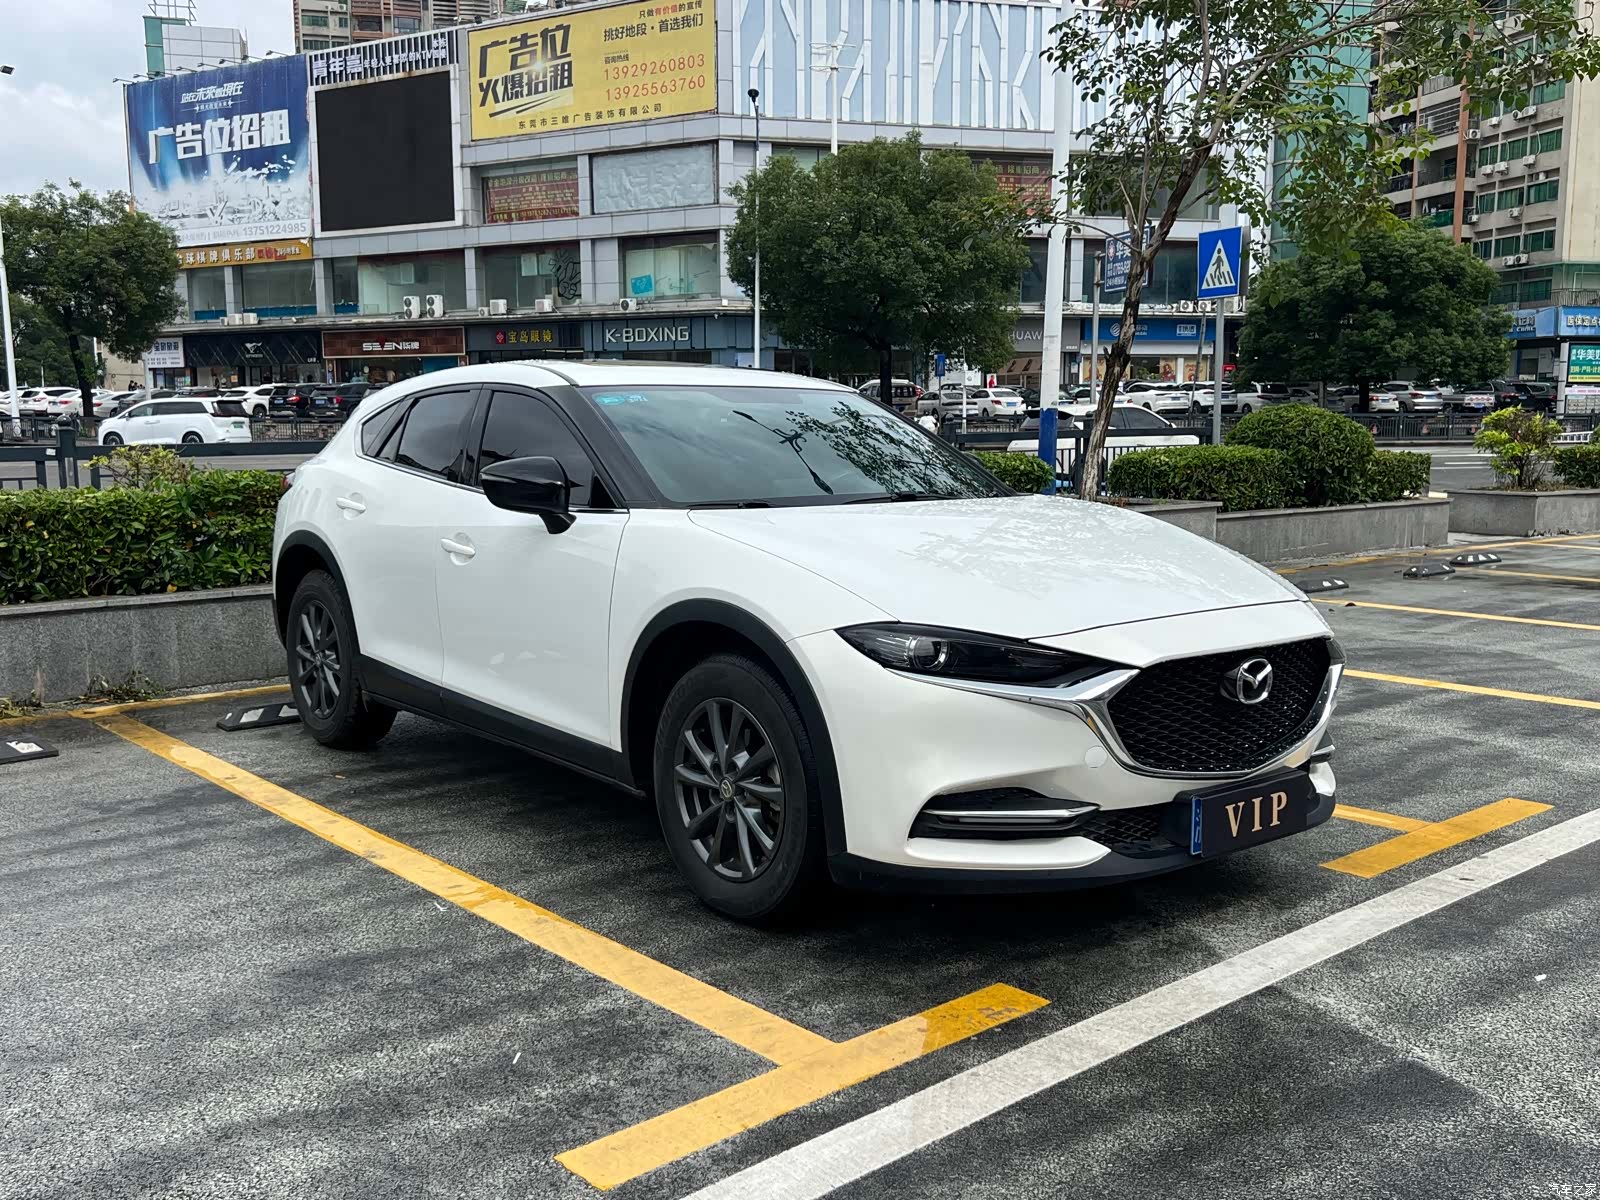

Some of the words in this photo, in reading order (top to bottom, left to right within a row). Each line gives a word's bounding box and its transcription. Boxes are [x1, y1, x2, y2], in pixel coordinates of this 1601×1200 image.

[478, 23, 571, 78] 广告位
[604, 54, 705, 81] 13929260803
[478, 60, 574, 107] 火爆招租
[605, 75, 706, 101] 13925563760
[149, 109, 291, 164] 广告位招租
[243, 223, 307, 236] 13751224985
[508, 329, 553, 343] 宝岛眼镜
[605, 326, 690, 344] K-BOXING
[1008, 330, 1043, 340] HUAW
[1225, 791, 1288, 838] VIP
